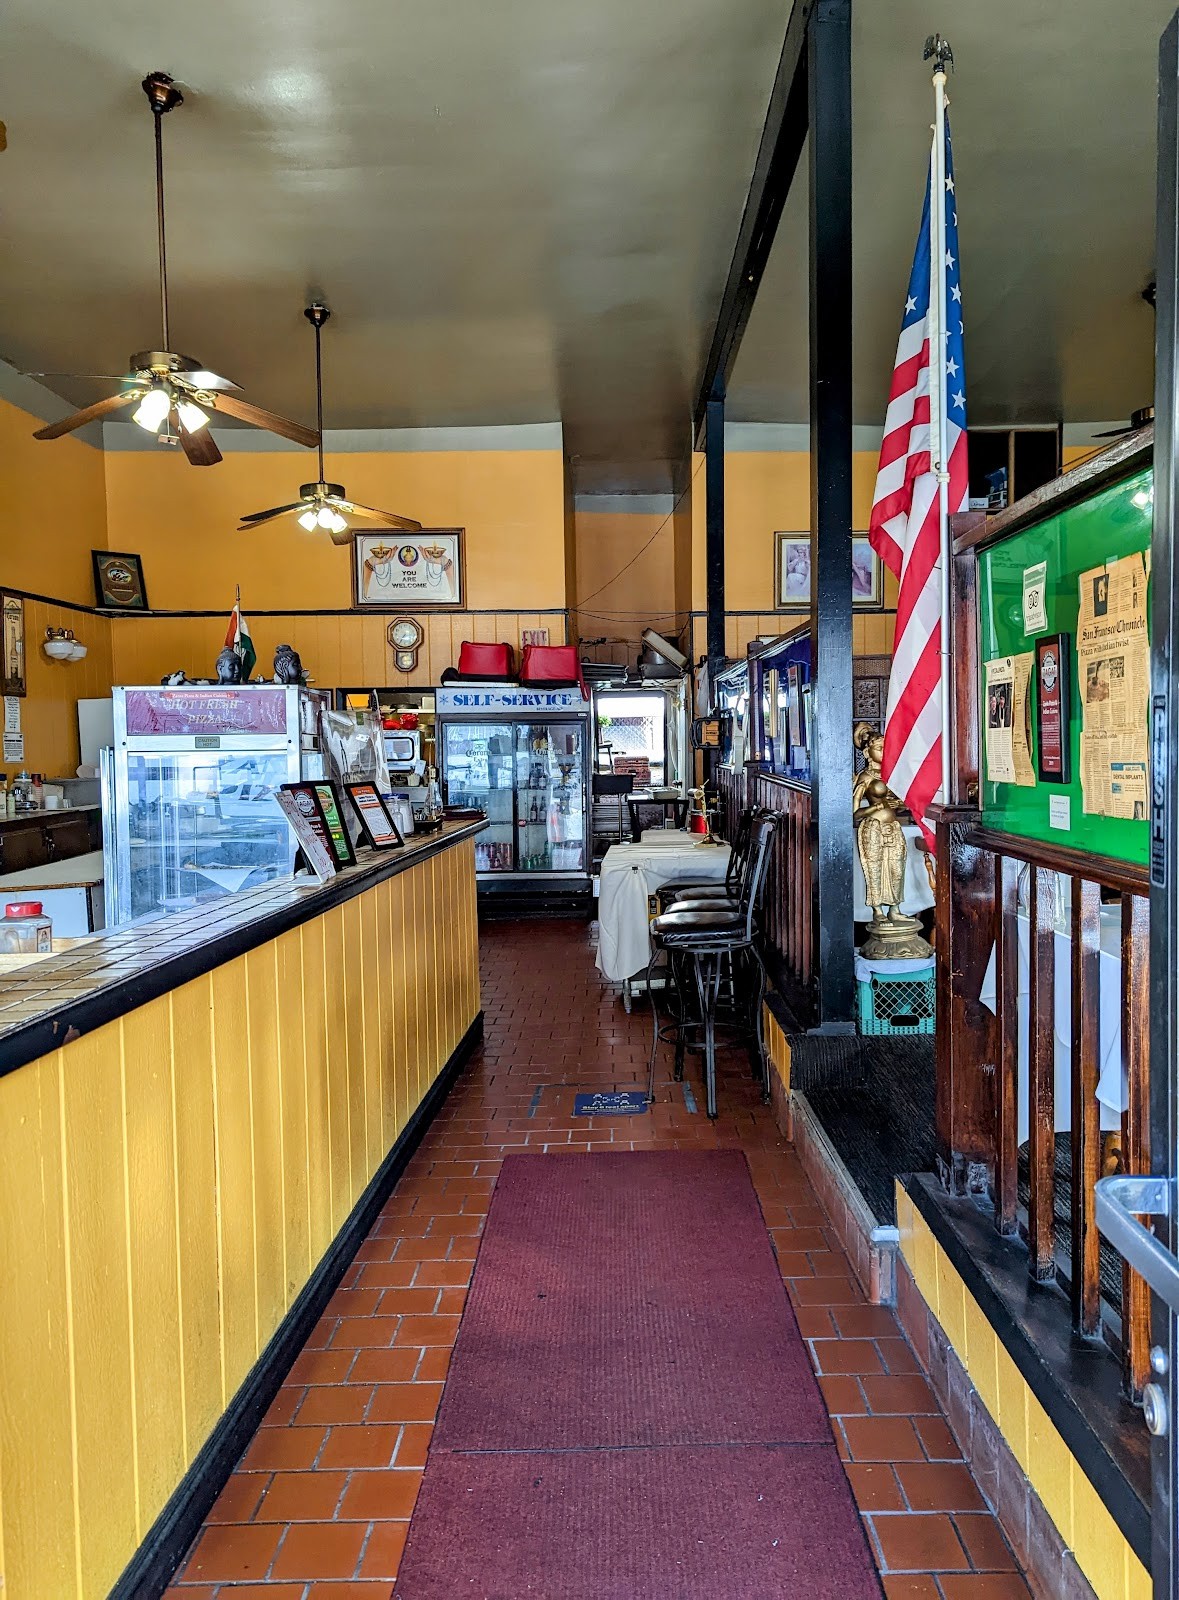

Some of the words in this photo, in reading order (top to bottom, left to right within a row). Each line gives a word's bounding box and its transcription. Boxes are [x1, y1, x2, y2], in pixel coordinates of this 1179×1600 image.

[521, 630, 547, 646] EXIT
[171, 699, 197, 710] HOT
[199, 699, 238, 710] FRESH
[453, 693, 572, 706] SELF-SERVICE
[187, 714, 222, 724] PIZZA
